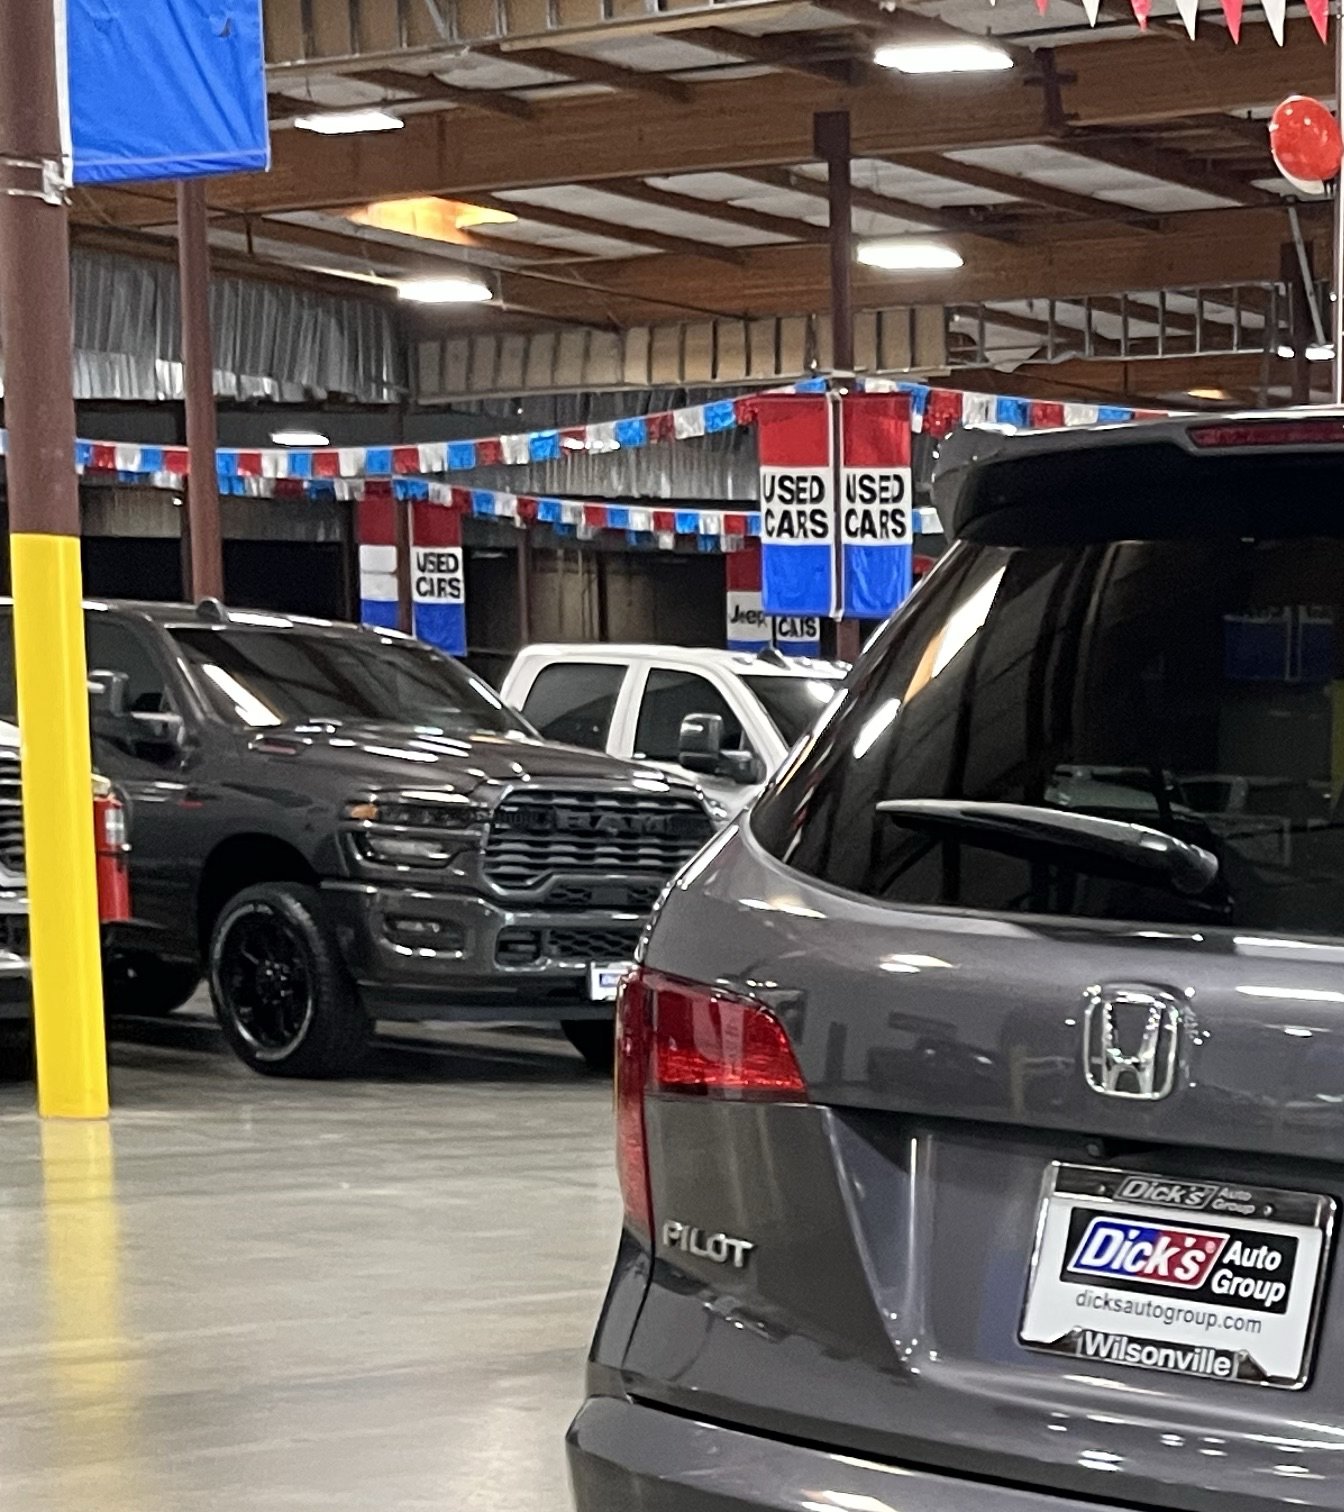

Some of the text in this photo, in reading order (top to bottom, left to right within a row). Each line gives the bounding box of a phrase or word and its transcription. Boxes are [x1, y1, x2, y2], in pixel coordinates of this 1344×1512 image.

[764, 474, 825, 504] USED
[846, 474, 904, 504] USED
[764, 509, 829, 538] CARS
[845, 508, 906, 539] CARS
[416, 552, 459, 574] USED
[415, 576, 461, 599] CARS
[662, 1219, 754, 1268] PILOT
[1081, 1227, 1207, 1281] Dick's
[1223, 1241, 1282, 1270] Auto
[1211, 1269, 1286, 1307] Group
[1075, 1289, 1262, 1334] dicksautogroup.com
[1084, 1331, 1232, 1377] Wilsonville
